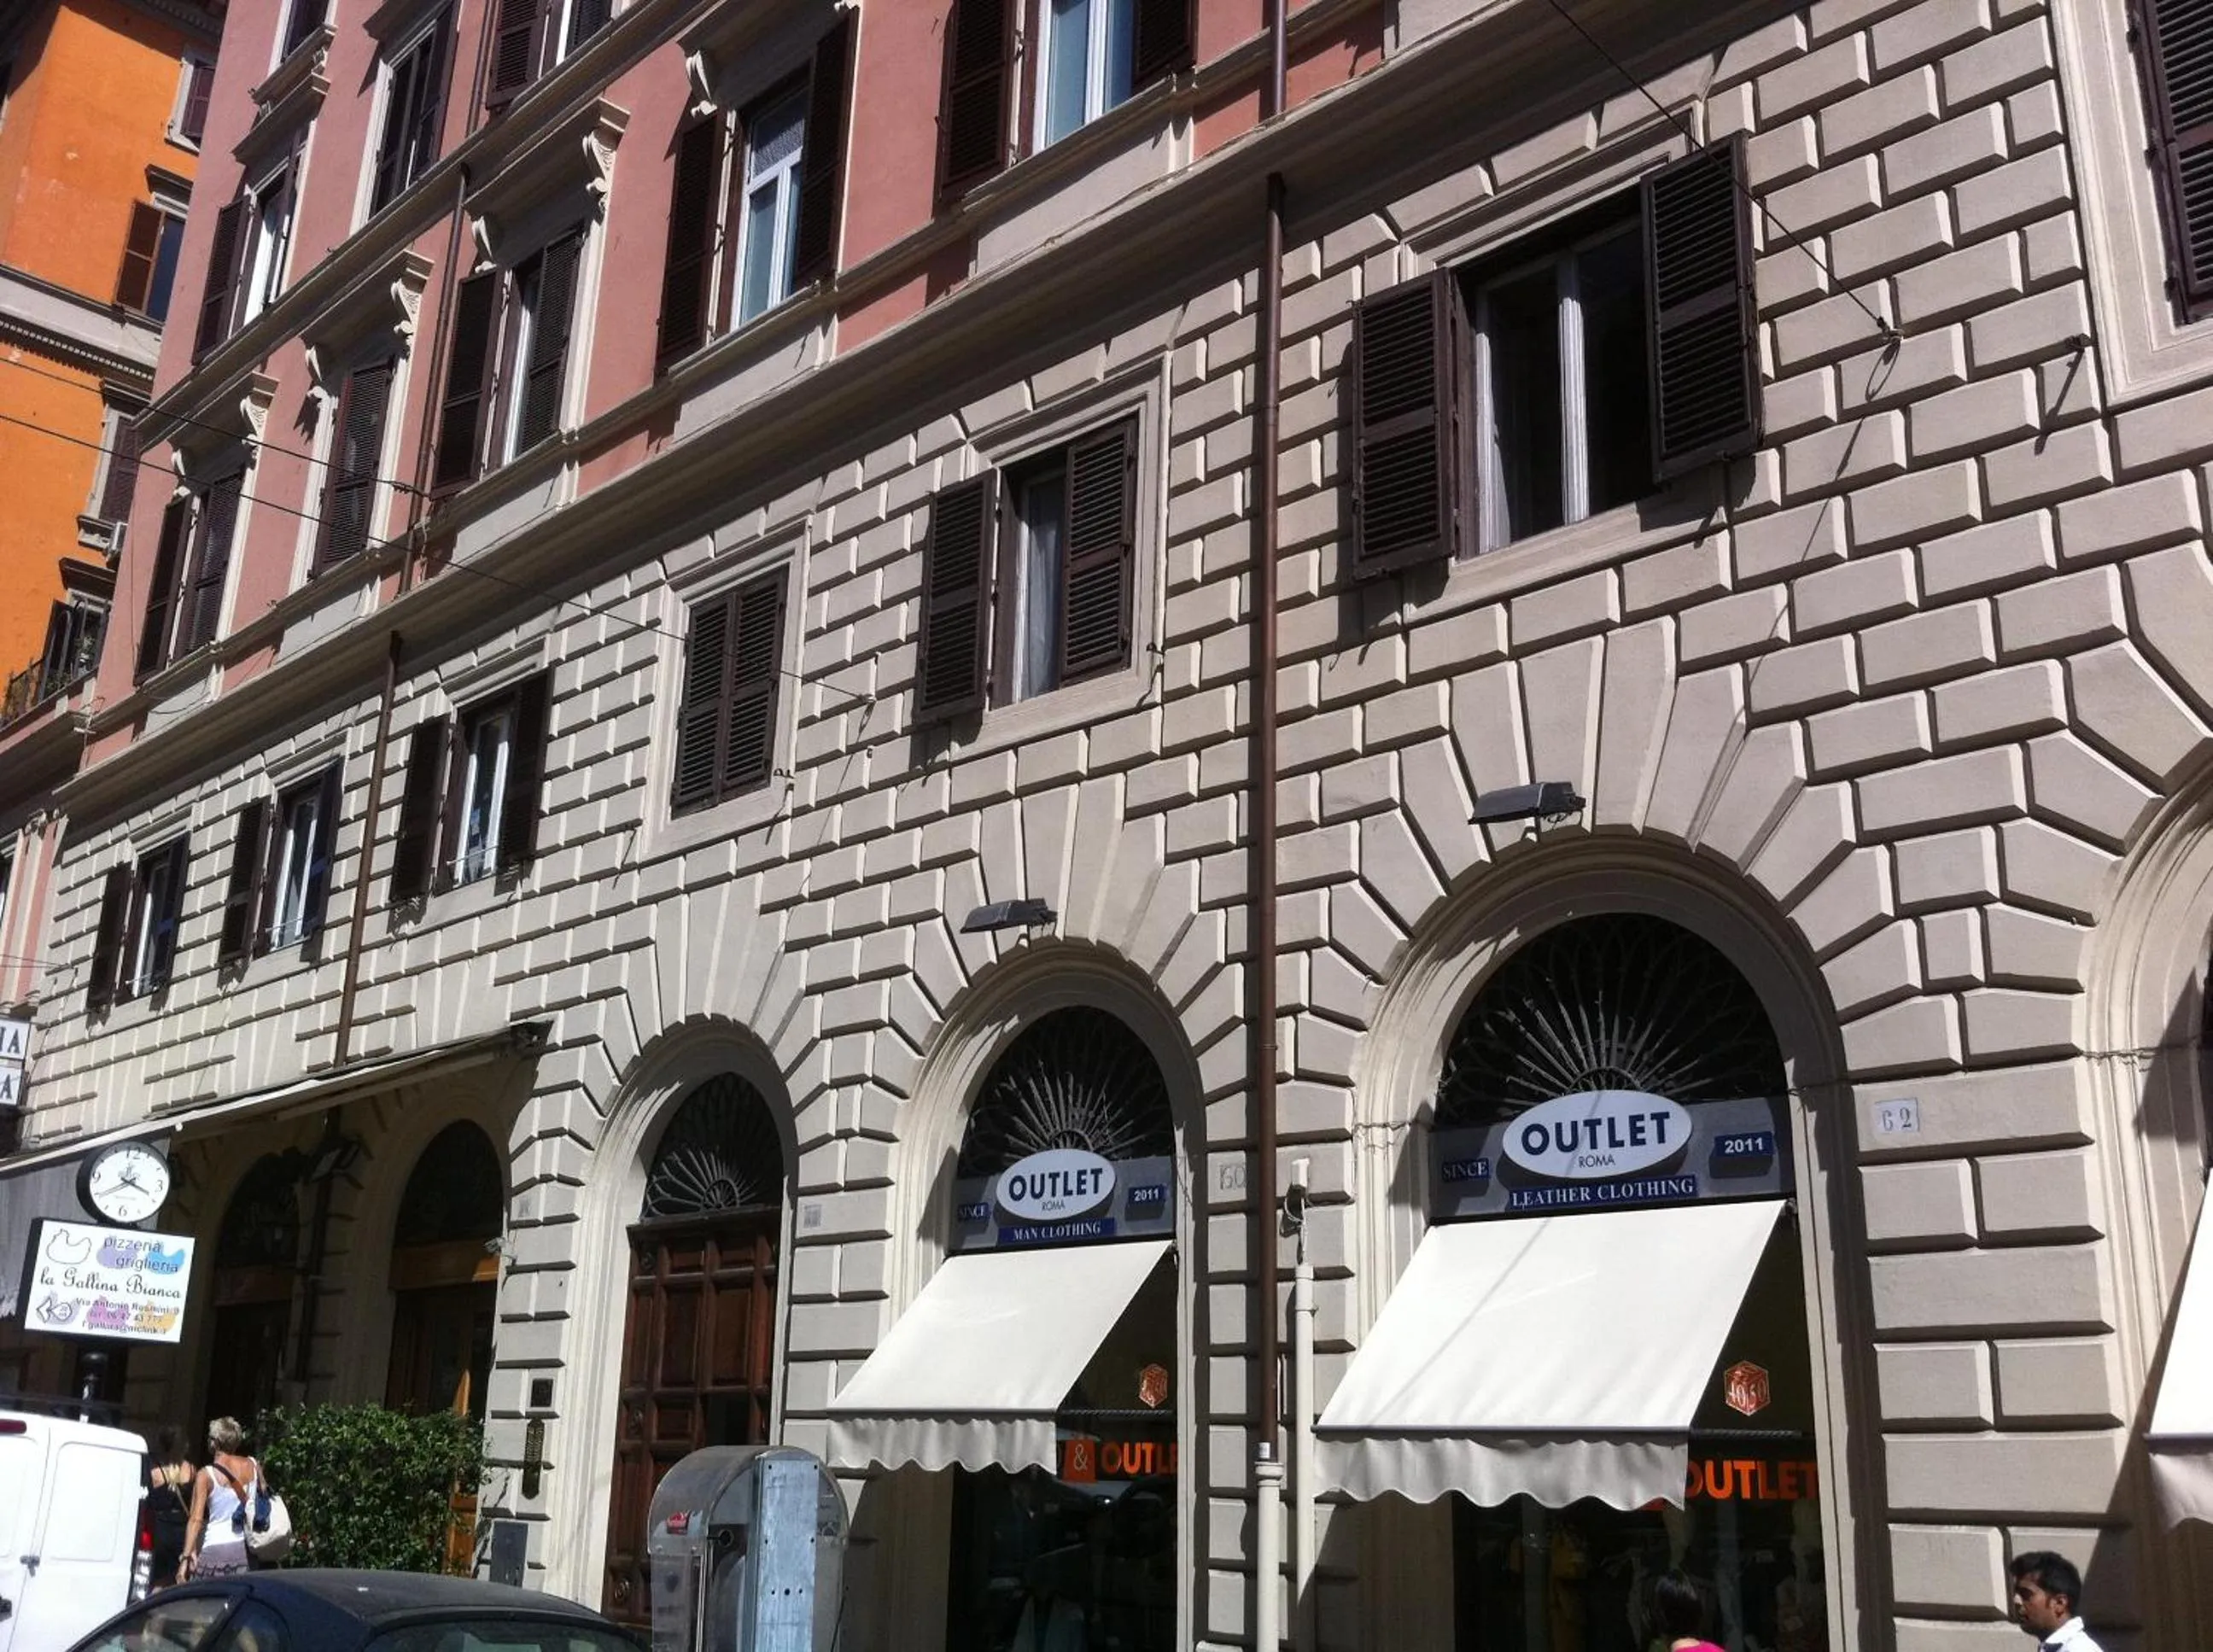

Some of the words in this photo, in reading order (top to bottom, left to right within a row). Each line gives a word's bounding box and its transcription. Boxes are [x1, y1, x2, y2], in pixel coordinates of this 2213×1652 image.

[1882, 1107, 1912, 1131] 62
[1520, 1112, 1670, 1155] OUTLET
[1723, 1137, 1765, 1154] 2011
[1443, 1161, 1488, 1177] SINCE
[1579, 1153, 1615, 1169] ROMA
[1008, 1168, 1103, 1201] OUTLET
[1512, 1186, 1591, 1206] LEATHER
[1597, 1177, 1694, 1200] CLOTHING
[1133, 1189, 1159, 1202] 2011
[1041, 1200, 1066, 1211] ROMA
[1013, 1226, 1038, 1240] MAN
[1041, 1221, 1101, 1238] CLOTHING
[103, 1235, 161, 1254] pizzeria
[40, 1266, 55, 1286] la
[63, 1267, 119, 1293] Gallina
[126, 1274, 181, 1299] Bianca
